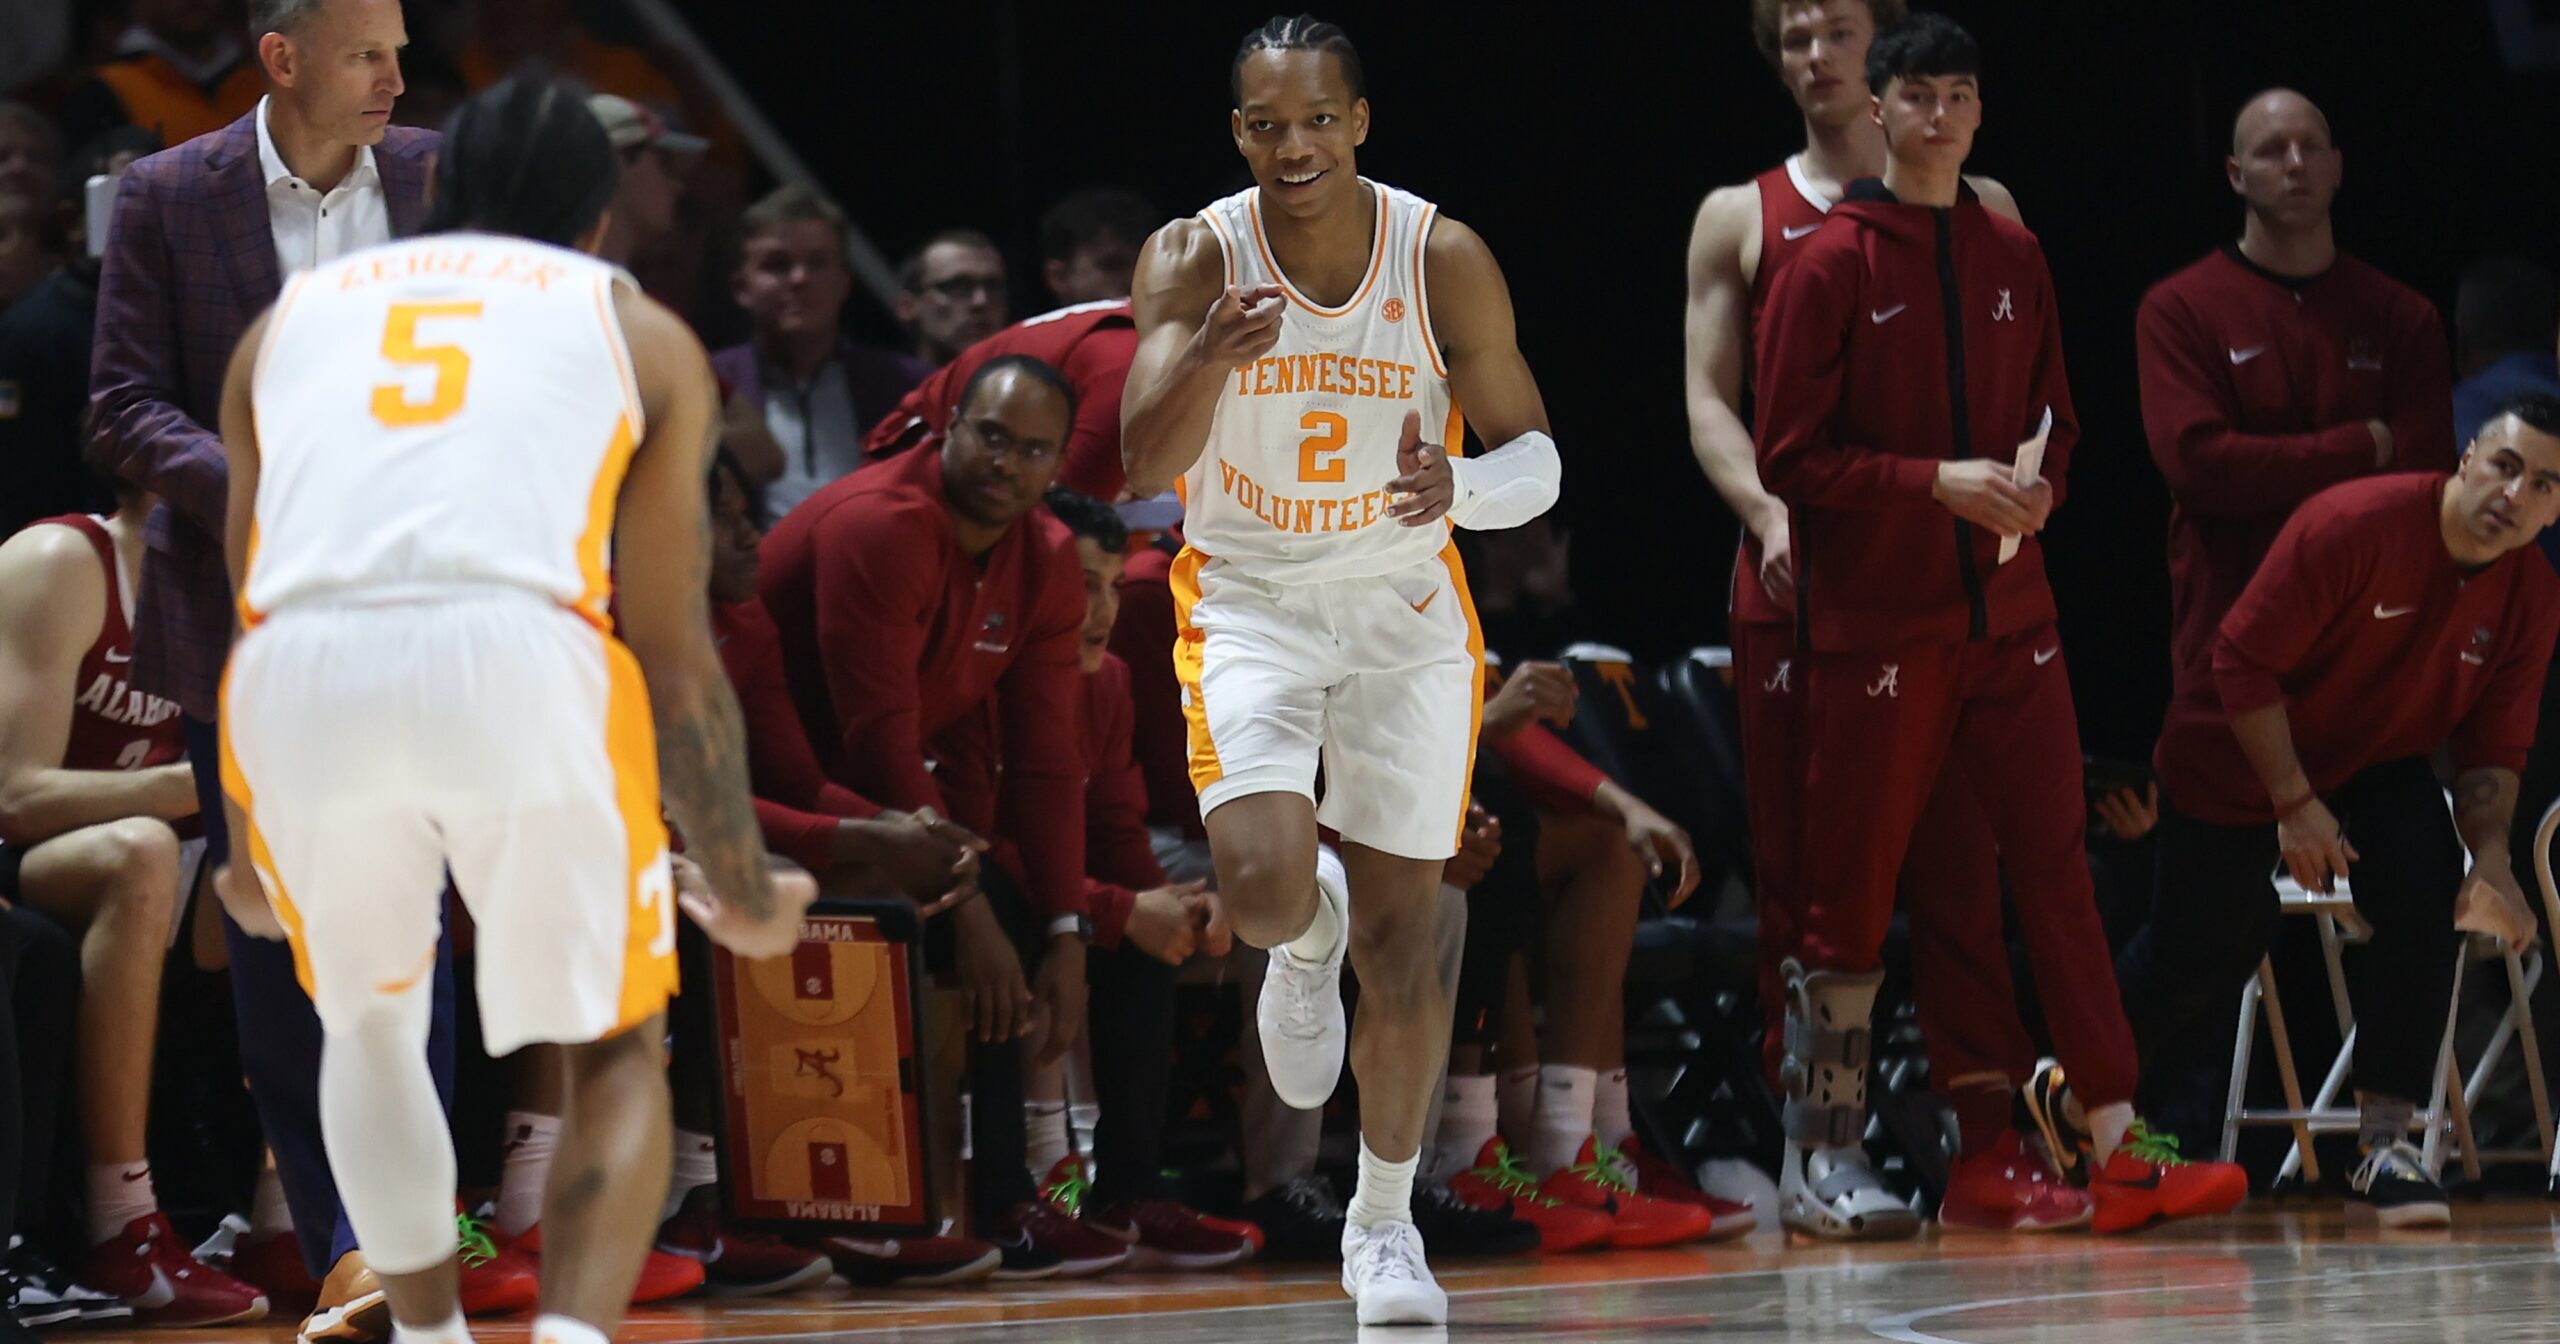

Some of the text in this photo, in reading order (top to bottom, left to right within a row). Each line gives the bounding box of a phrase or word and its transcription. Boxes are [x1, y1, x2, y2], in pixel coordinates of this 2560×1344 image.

[369, 301, 484, 429] 5
[1235, 352, 1416, 400] TENNESSEE
[1297, 410, 1348, 483] 2
[1219, 458, 1416, 534] VOLUNTEE
[798, 922, 854, 942] BAMA
